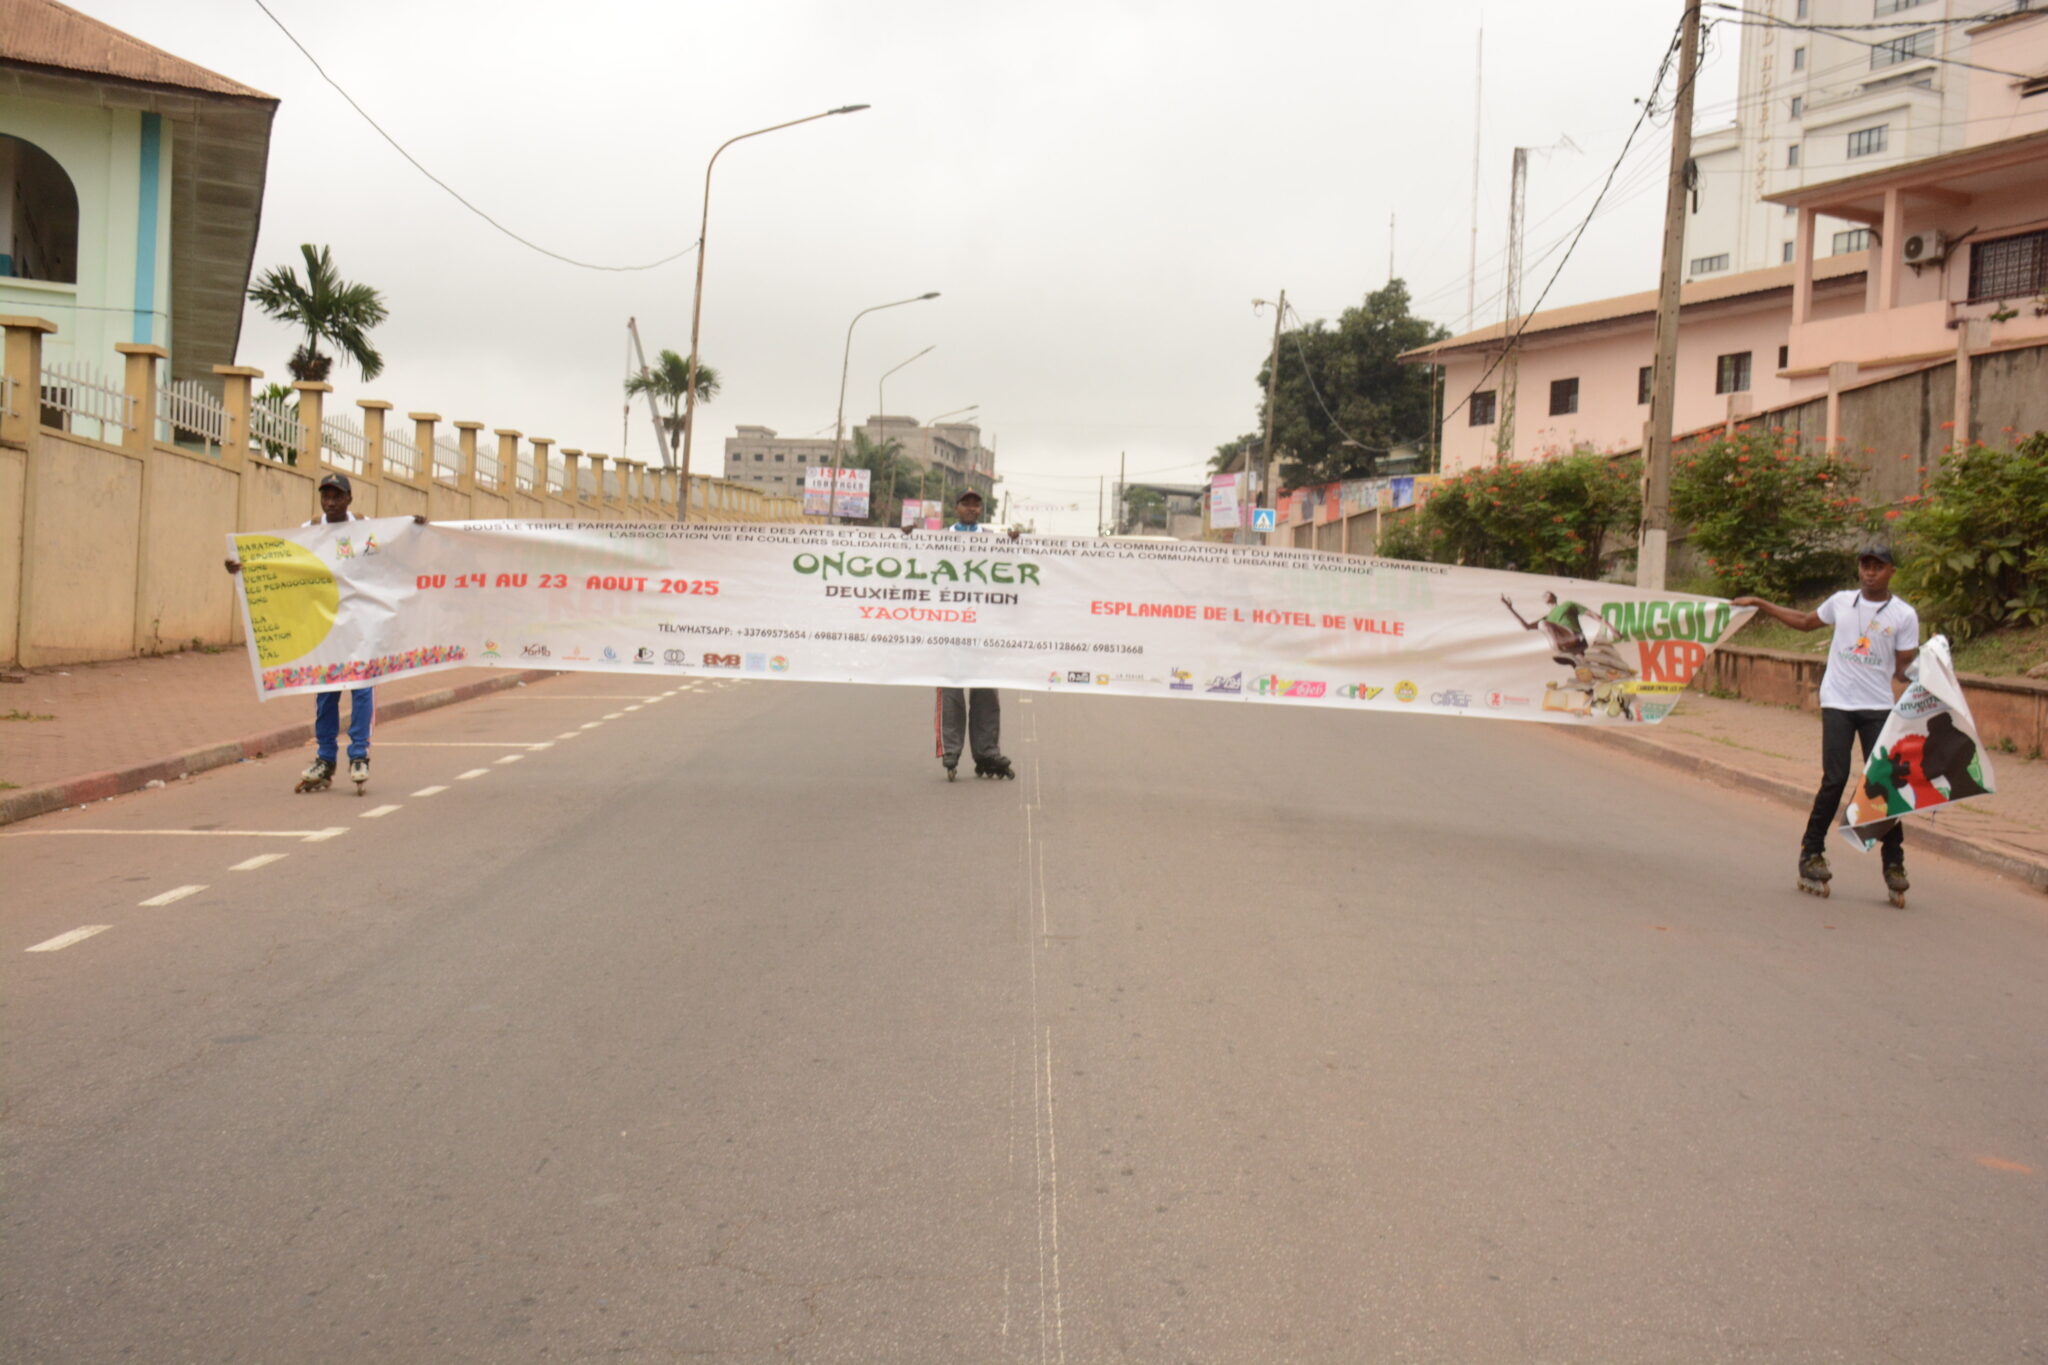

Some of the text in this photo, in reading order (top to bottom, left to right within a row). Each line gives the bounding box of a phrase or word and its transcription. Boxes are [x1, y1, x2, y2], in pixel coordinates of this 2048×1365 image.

[527, 522, 574, 531] TRIPLE
[578, 522, 667, 532] PARRAINAGE
[671, 523, 690, 532] DU
[770, 526, 796, 536] DES
[800, 527, 834, 538] ARTS
[838, 528, 854, 539] ET
[859, 530, 873, 540] DE
[880, 531, 896, 541] LA
[970, 536, 988, 545] DU
[1072, 539, 1087, 549] DE
[1093, 540, 1110, 550] LA
[1113, 541, 1228, 555] COMMUNICATION
[1232, 548, 1249, 557] ET
[1253, 549, 1269, 558] DU
[1348, 558, 1367, 566] DU
[1370, 559, 1449, 576] COMMERCE
[609, 531, 708, 541] L'ASSOCIATION
[712, 533, 732, 542] VIE
[736, 534, 753, 543] EN
[757, 535, 828, 546] COULEURS
[969, 545, 987, 554] EN
[990, 546, 1077, 557] PARTENARIAT
[1081, 550, 1116, 559] AVEC
[1119, 551, 1136, 560] LA
[1233, 557, 1291, 569] URBAINE
[1292, 561, 1309, 570] DE
[416, 573, 719, 597] DU 14 AU 23 AOUT 2025
[793, 551, 1040, 586] ONGOLAKER
[825, 584, 1019, 605] DEUXIÈME ÉDITION
[859, 605, 977, 624] YAOUNDÉ
[1091, 600, 1197, 620] ESPLANADE
[1204, 606, 1227, 622] DE
[1252, 608, 1316, 628] HÔTEL
[1323, 614, 1346, 630] DE
[1353, 617, 1404, 636] VILLE
